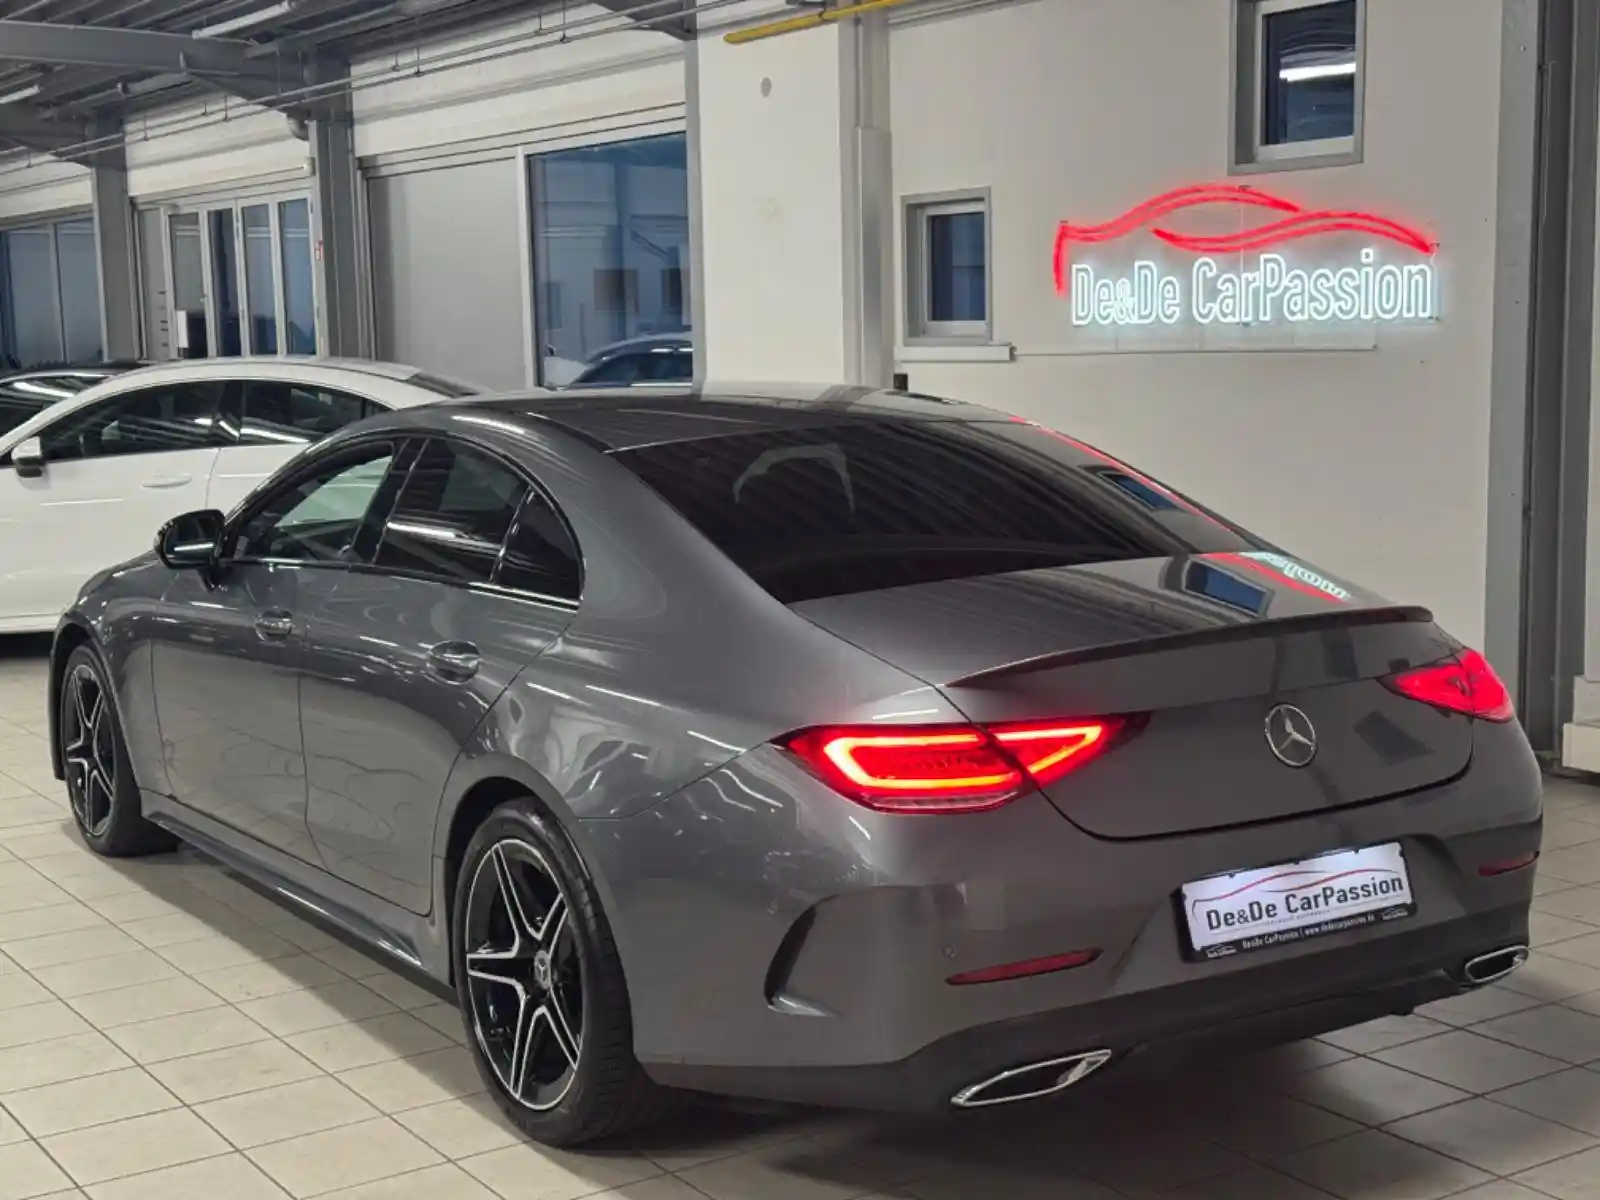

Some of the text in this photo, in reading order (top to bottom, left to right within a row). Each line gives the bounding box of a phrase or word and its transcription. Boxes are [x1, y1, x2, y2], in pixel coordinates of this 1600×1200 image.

[1071, 247, 1433, 326] De&De CarPassion
[1206, 900, 1278, 931] De&De
[1285, 876, 1404, 914] CarPassion
